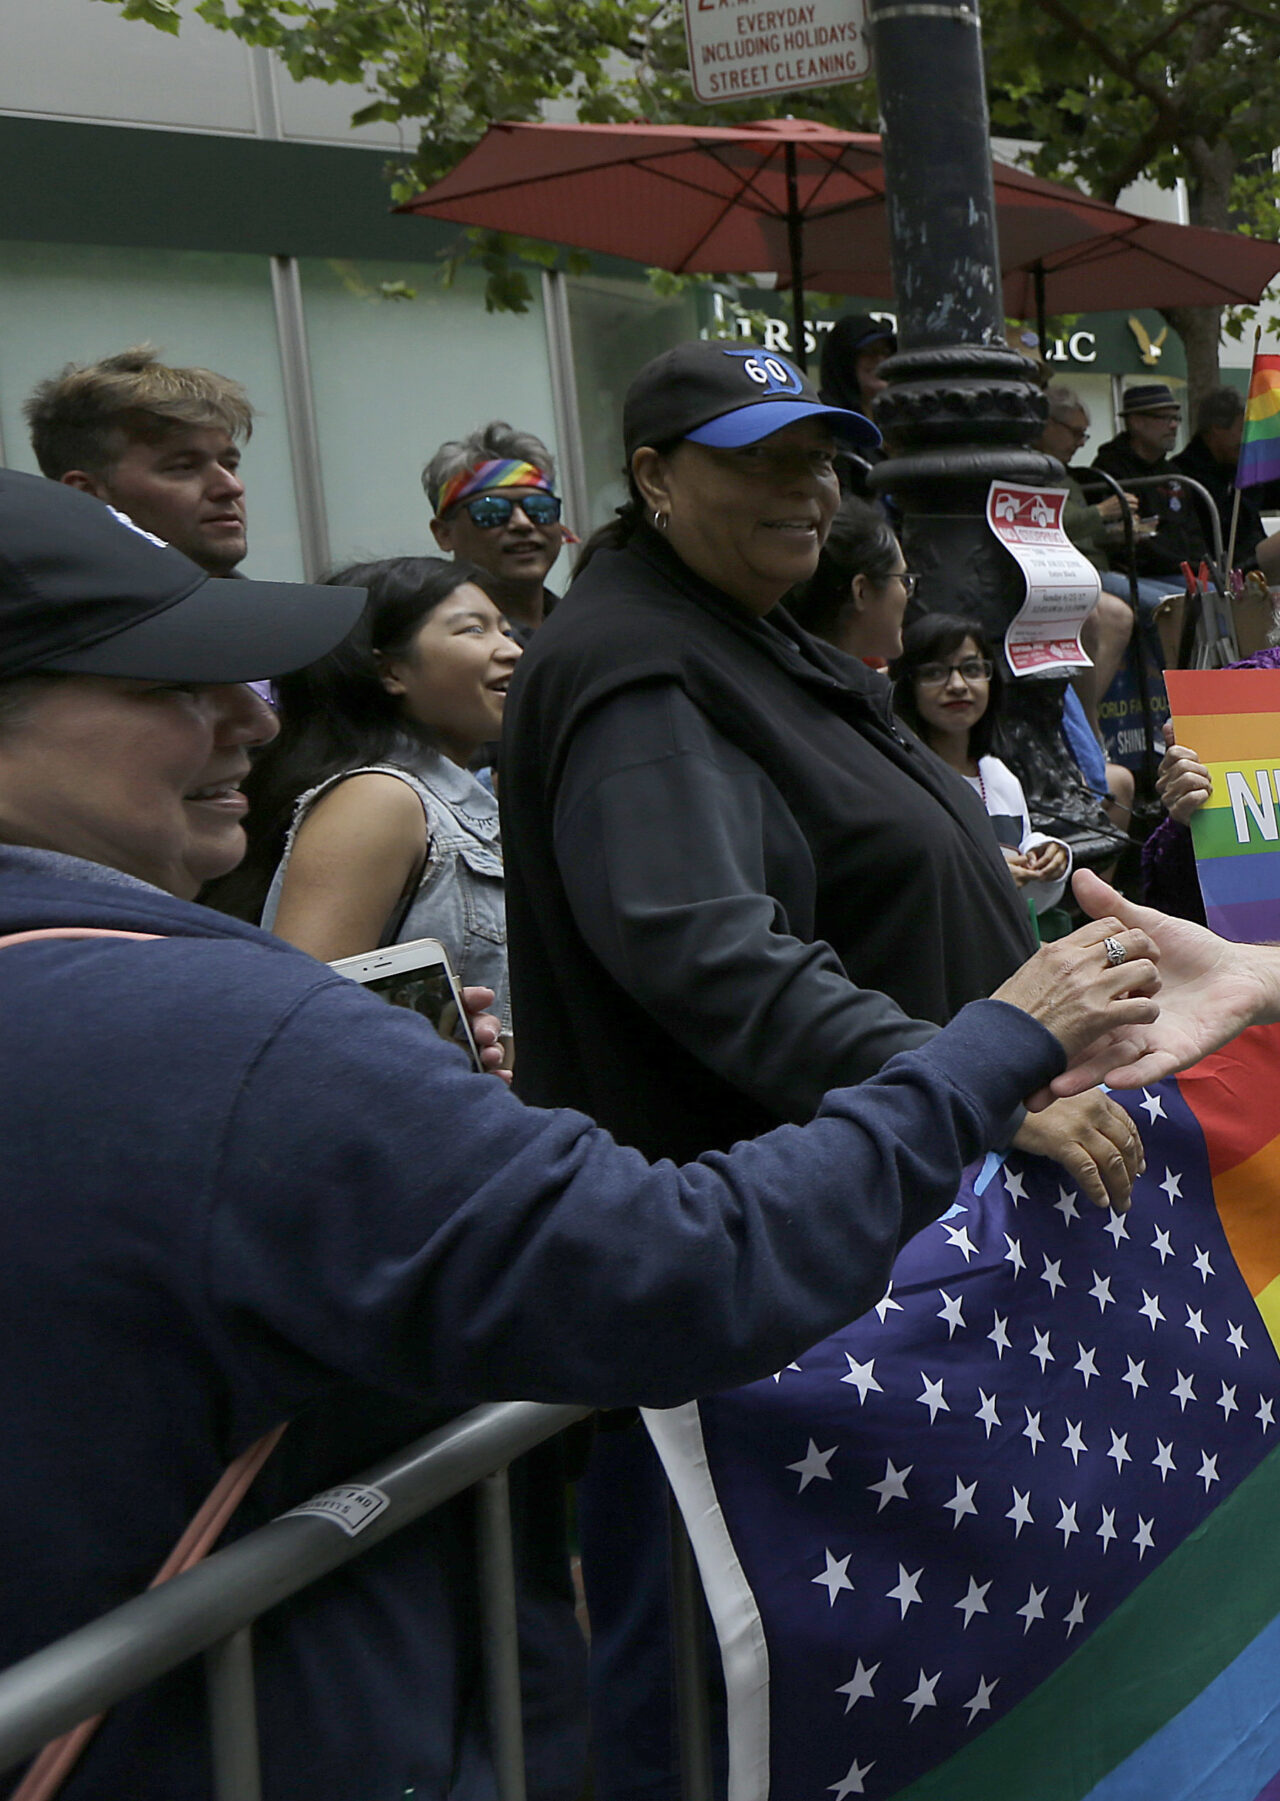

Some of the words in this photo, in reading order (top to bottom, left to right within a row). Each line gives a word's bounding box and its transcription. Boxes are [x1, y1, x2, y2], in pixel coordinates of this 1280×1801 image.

[736, 5, 816, 35] EVERYDAY
[701, 36, 780, 66] INCLUDING
[784, 22, 857, 51] HOLIDAYS
[709, 65, 769, 93] STREET
[775, 51, 857, 82] CLEANING
[744, 358, 788, 384] 60
